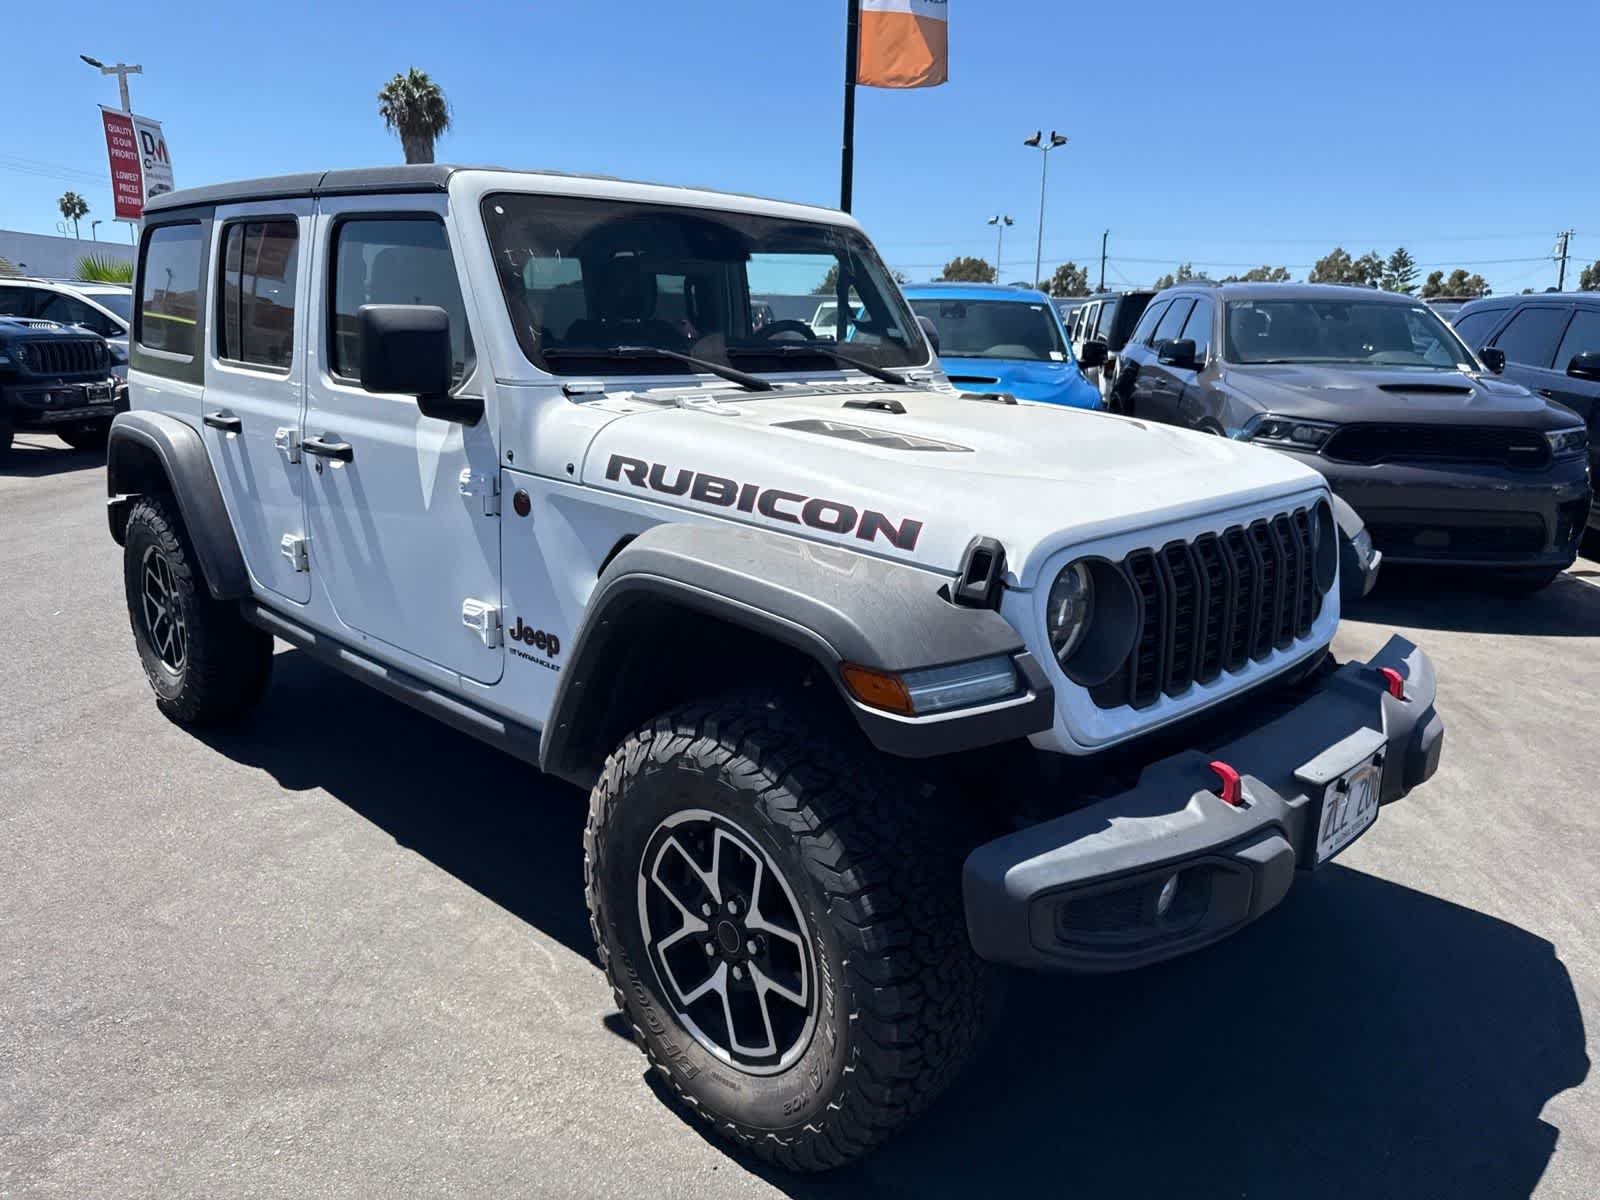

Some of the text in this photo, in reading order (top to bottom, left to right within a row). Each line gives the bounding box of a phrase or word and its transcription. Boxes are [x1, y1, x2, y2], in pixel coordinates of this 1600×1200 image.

[107, 123, 132, 136] QUALITY
[119, 138, 132, 147] OUR
[111, 148, 138, 160] PRIORITY
[116, 170, 139, 181] LOWEST
[119, 183, 139, 193] PRICES
[125, 196, 142, 206] TOWN
[605, 454, 923, 552] RUBICON
[509, 616, 560, 658] Jeep
